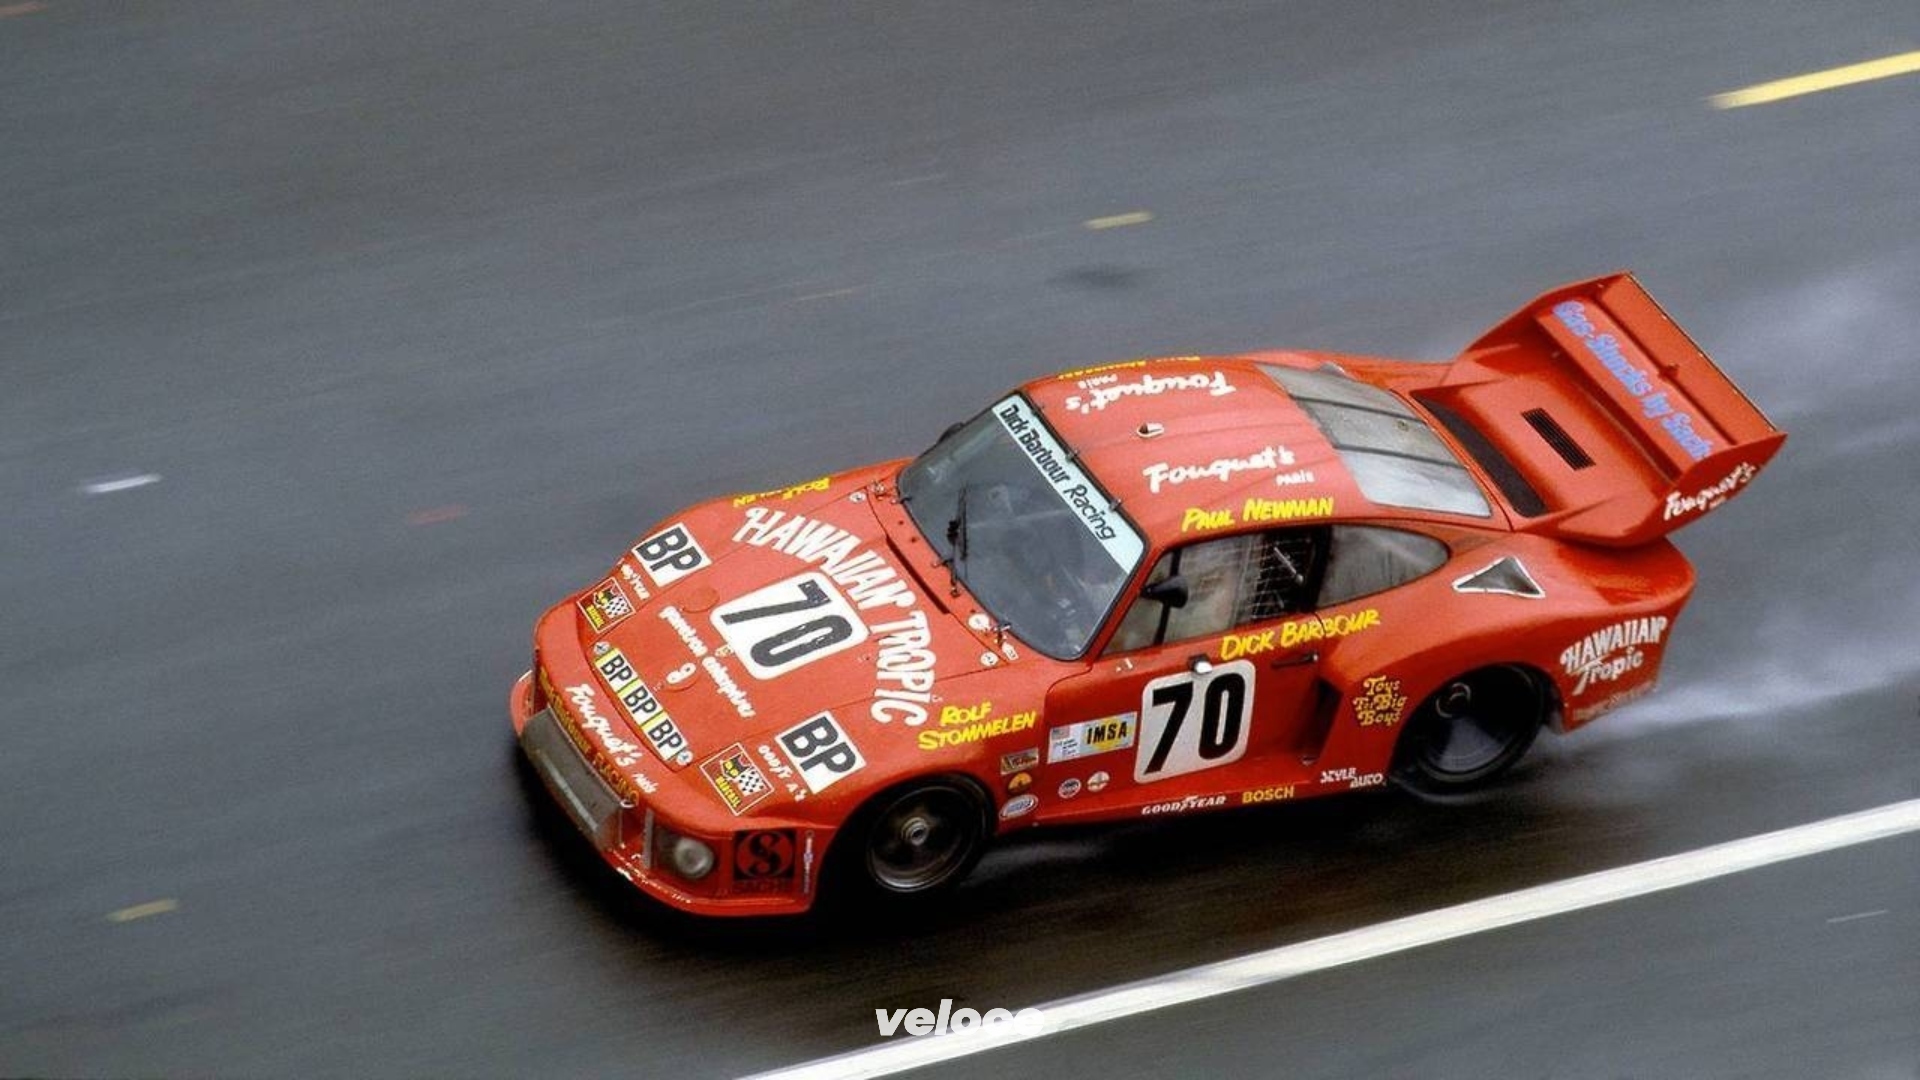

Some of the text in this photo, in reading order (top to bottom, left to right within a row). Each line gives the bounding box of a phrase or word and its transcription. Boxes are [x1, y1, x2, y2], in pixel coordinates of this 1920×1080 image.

[1001, 404, 1116, 541] Dick Barbour Racing
[1181, 496, 1335, 533] PAUL NEWMAN
[635, 526, 703, 573] BP
[720, 579, 853, 668] 70
[732, 506, 937, 727] HAWAIIAN TROPIC
[1220, 609, 1381, 661] DICK BARBOUR
[1560, 615, 1668, 675] HAWAIIAN
[1363, 675, 1401, 696] Toys
[1570, 645, 1645, 697] Tropic
[600, 654, 633, 683] BP
[622, 685, 658, 715] BP
[648, 719, 683, 750] BP
[940, 701, 993, 727] ROLF
[1143, 672, 1246, 776] 70
[1357, 709, 1402, 726] Boys
[1373, 692, 1408, 713] Big
[780, 715, 857, 774] BP
[918, 710, 1037, 751] STOMMELEN
[1086, 720, 1129, 745] IMSA
[1141, 794, 1227, 815] GOODYEAR
[1242, 785, 1295, 804] BOSCH
